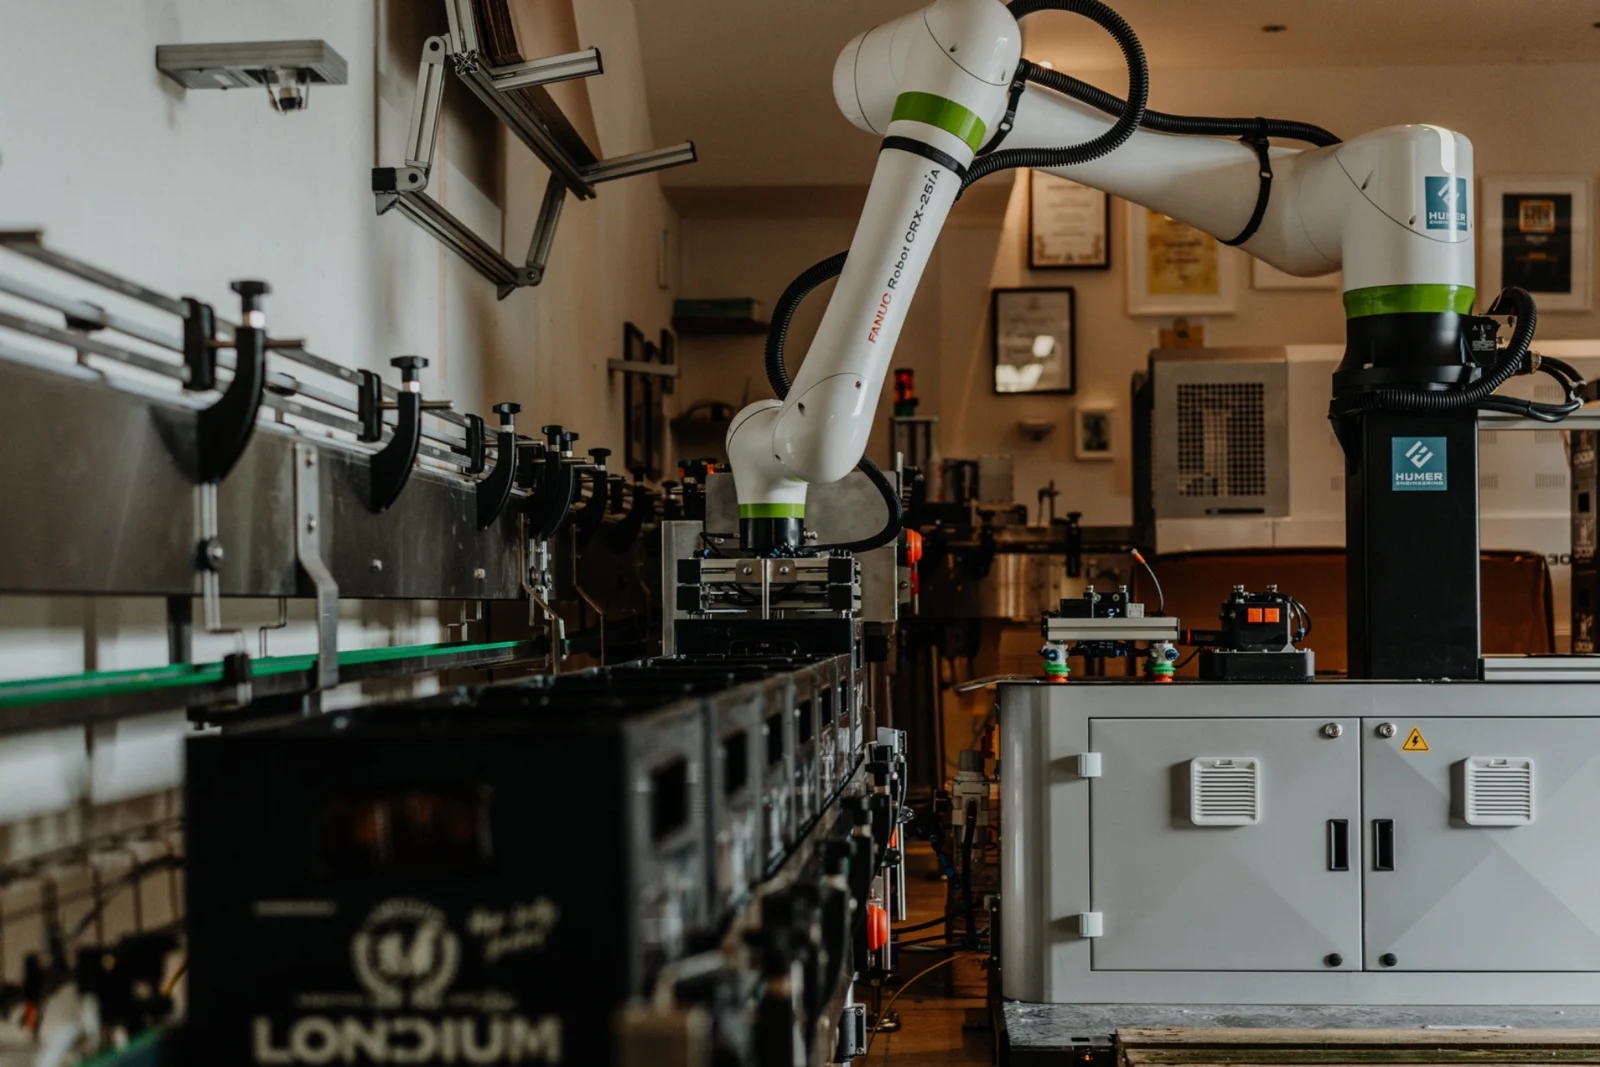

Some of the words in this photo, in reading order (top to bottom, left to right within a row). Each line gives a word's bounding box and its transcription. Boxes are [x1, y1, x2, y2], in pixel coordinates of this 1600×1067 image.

[867, 292, 892, 344] FANUC
[887, 246, 910, 290] Robot
[905, 169, 940, 243] CRX-25iA
[1395, 472, 1443, 481] HUMER
